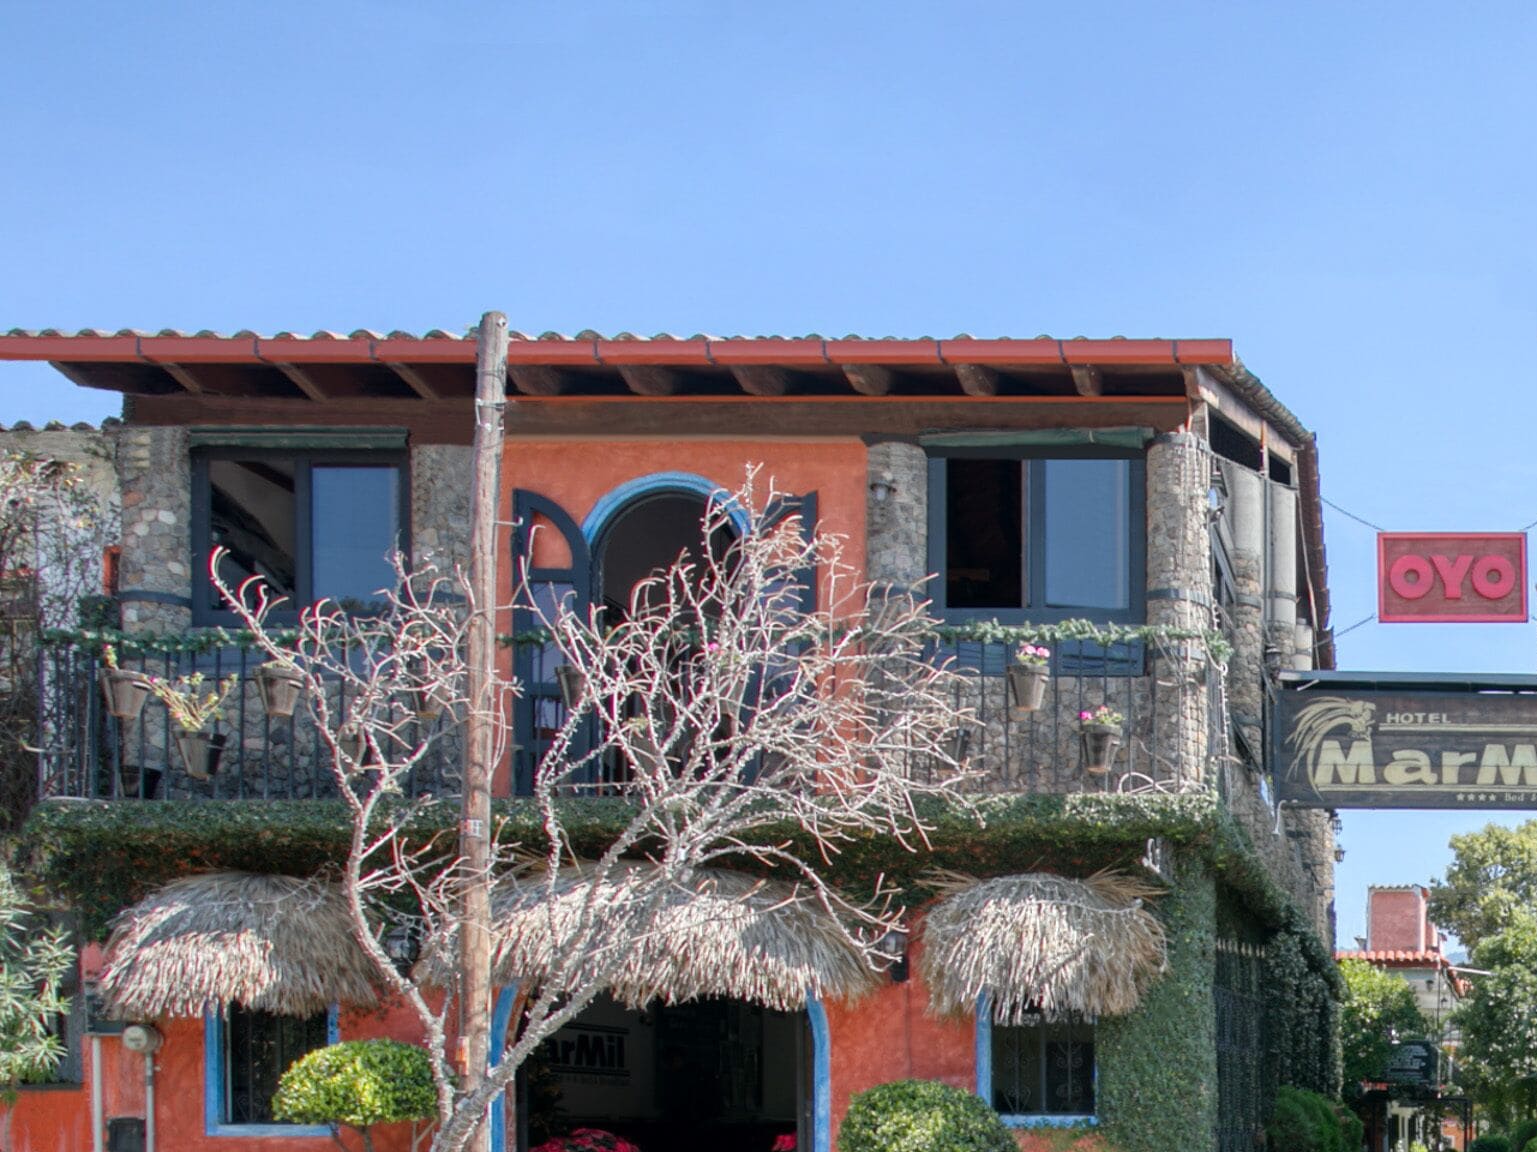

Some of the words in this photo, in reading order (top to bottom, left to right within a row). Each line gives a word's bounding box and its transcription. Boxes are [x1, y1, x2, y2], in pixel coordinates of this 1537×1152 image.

[1389, 554, 1516, 600] OYO
[1386, 712, 1452, 724] HOTEL
[543, 1033, 624, 1067] arMil
